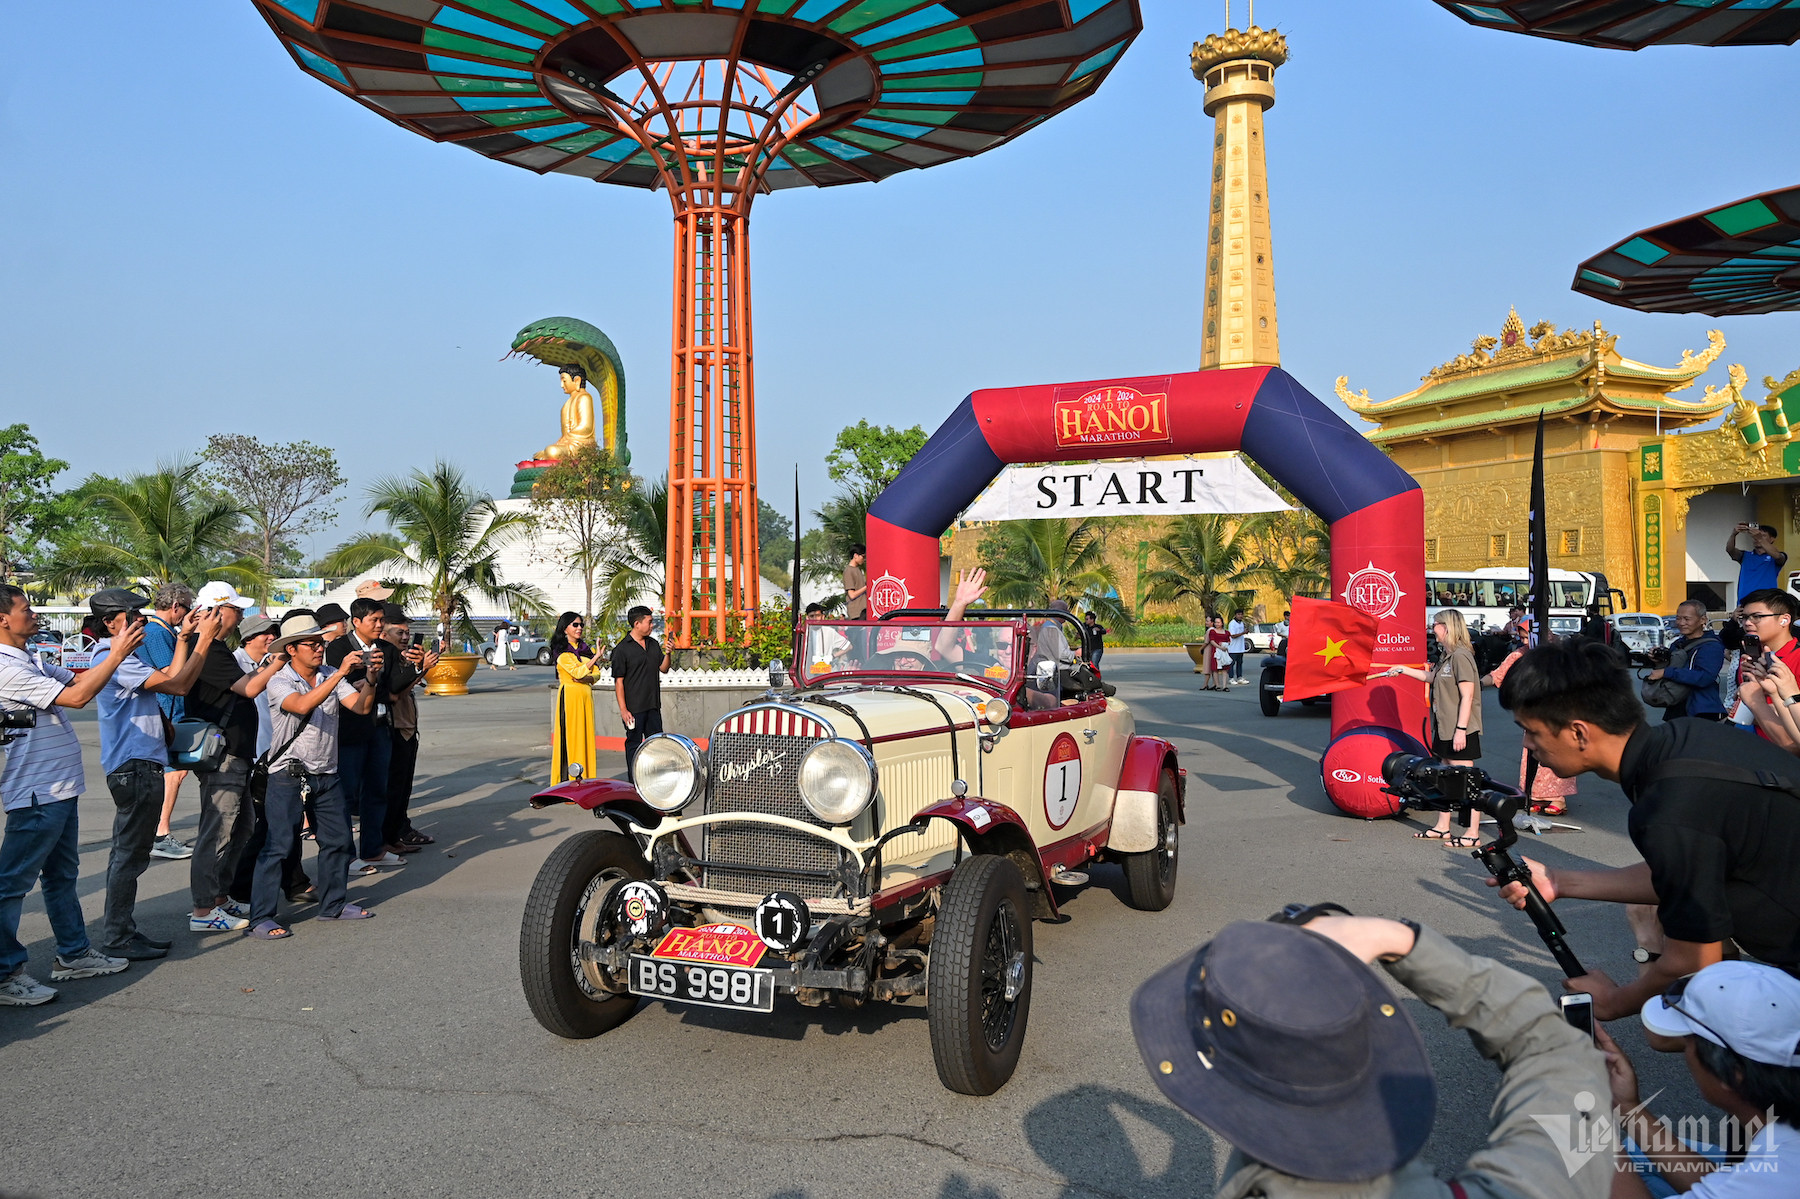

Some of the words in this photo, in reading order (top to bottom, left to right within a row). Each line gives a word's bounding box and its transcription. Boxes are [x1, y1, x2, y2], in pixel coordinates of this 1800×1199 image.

[1084, 392, 1101, 404] 2024
[1105, 389, 1112, 402] 1
[1117, 390, 1134, 401] 2024
[1087, 402, 1113, 412] ROAD
[1117, 400, 1130, 409] TO
[1060, 399, 1162, 439] HANOI
[1080, 431, 1140, 442] MARATHON
[1036, 469, 1204, 509] START
[876, 588, 901, 608] RTG
[1355, 583, 1390, 606] RTG
[1377, 633, 1410, 644] Globe
[720, 748, 786, 782] Chrysler
[767, 761, 783, 777] 75
[1059, 765, 1067, 802] 1
[1338, 771, 1353, 781] RM
[772, 912, 782, 935] 1
[663, 933, 761, 962] HANOI
[677, 950, 732, 962] MARATHON
[639, 960, 677, 994] BS
[687, 967, 763, 1005] 9981
